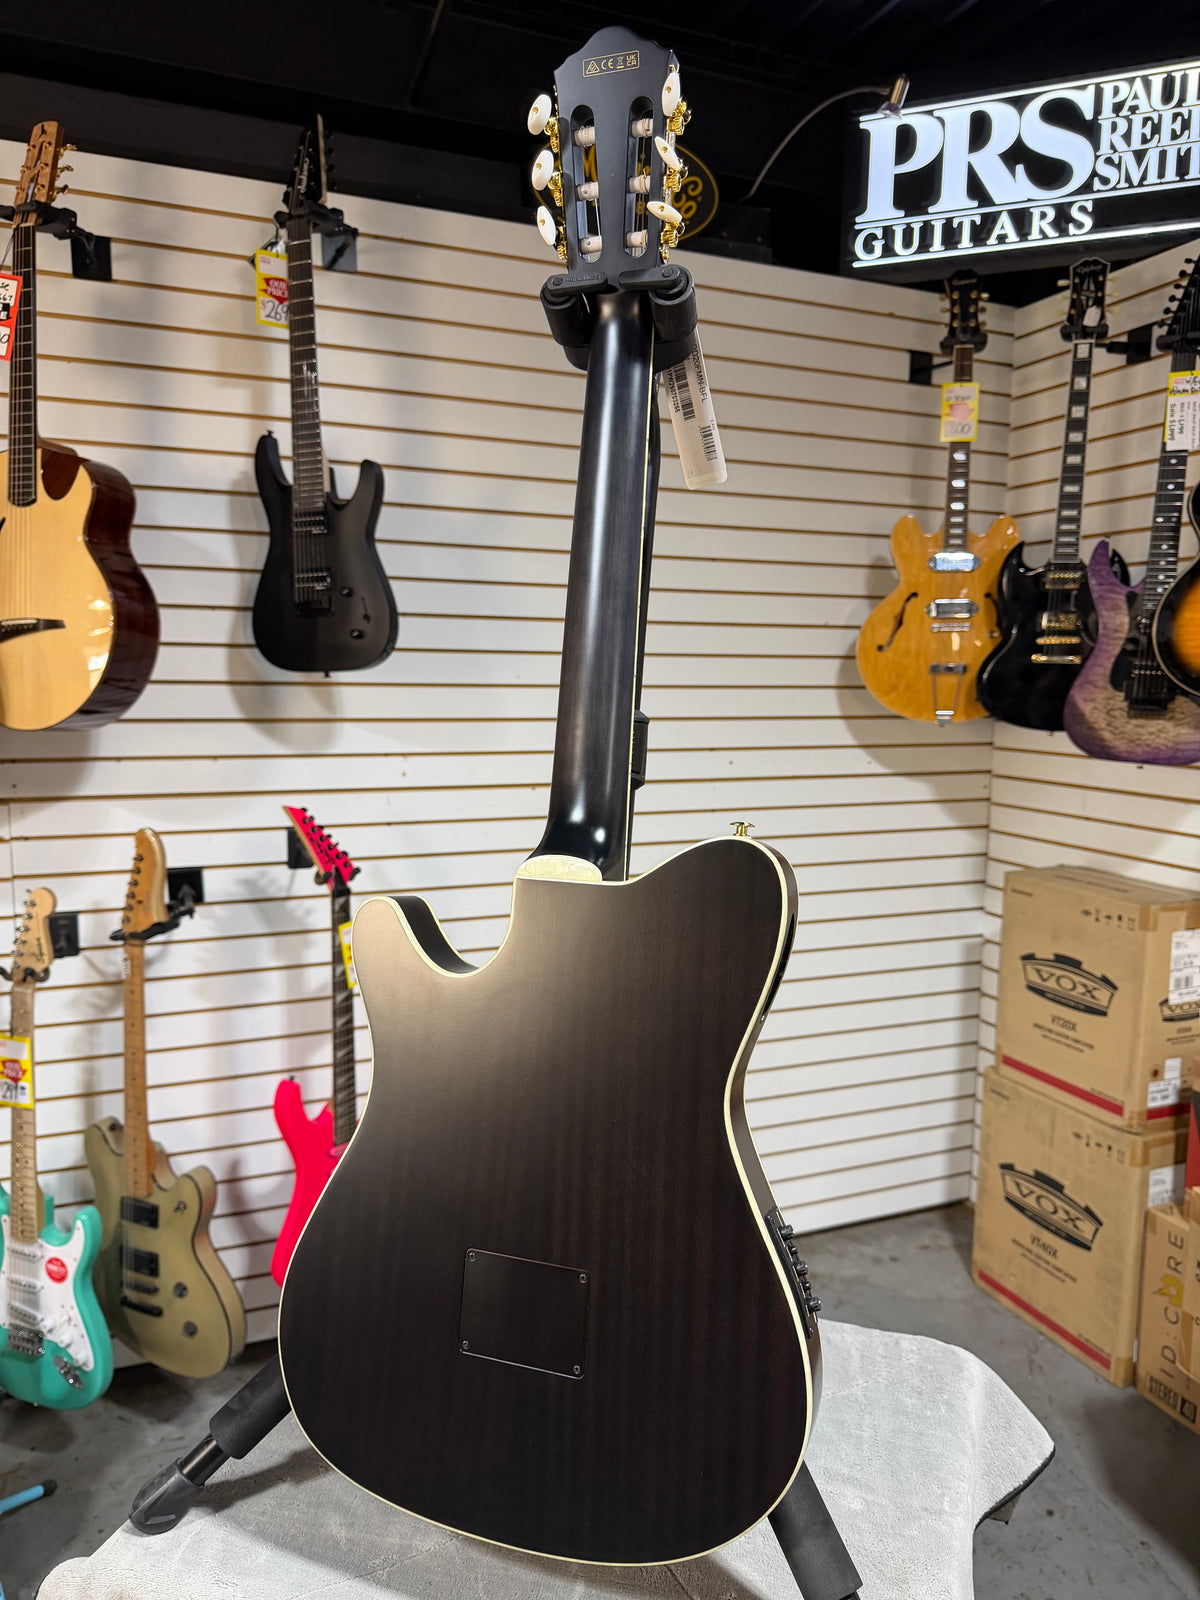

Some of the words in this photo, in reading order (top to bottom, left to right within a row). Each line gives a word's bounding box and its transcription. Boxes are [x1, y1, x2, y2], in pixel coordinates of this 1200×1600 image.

[601, 58, 614, 70] CE
[855, 85, 1095, 223] PRS
[854, 200, 1093, 261] GUITARS
[1031, 966, 1101, 1002] VOX
[1009, 1177, 1085, 1233] VOX
